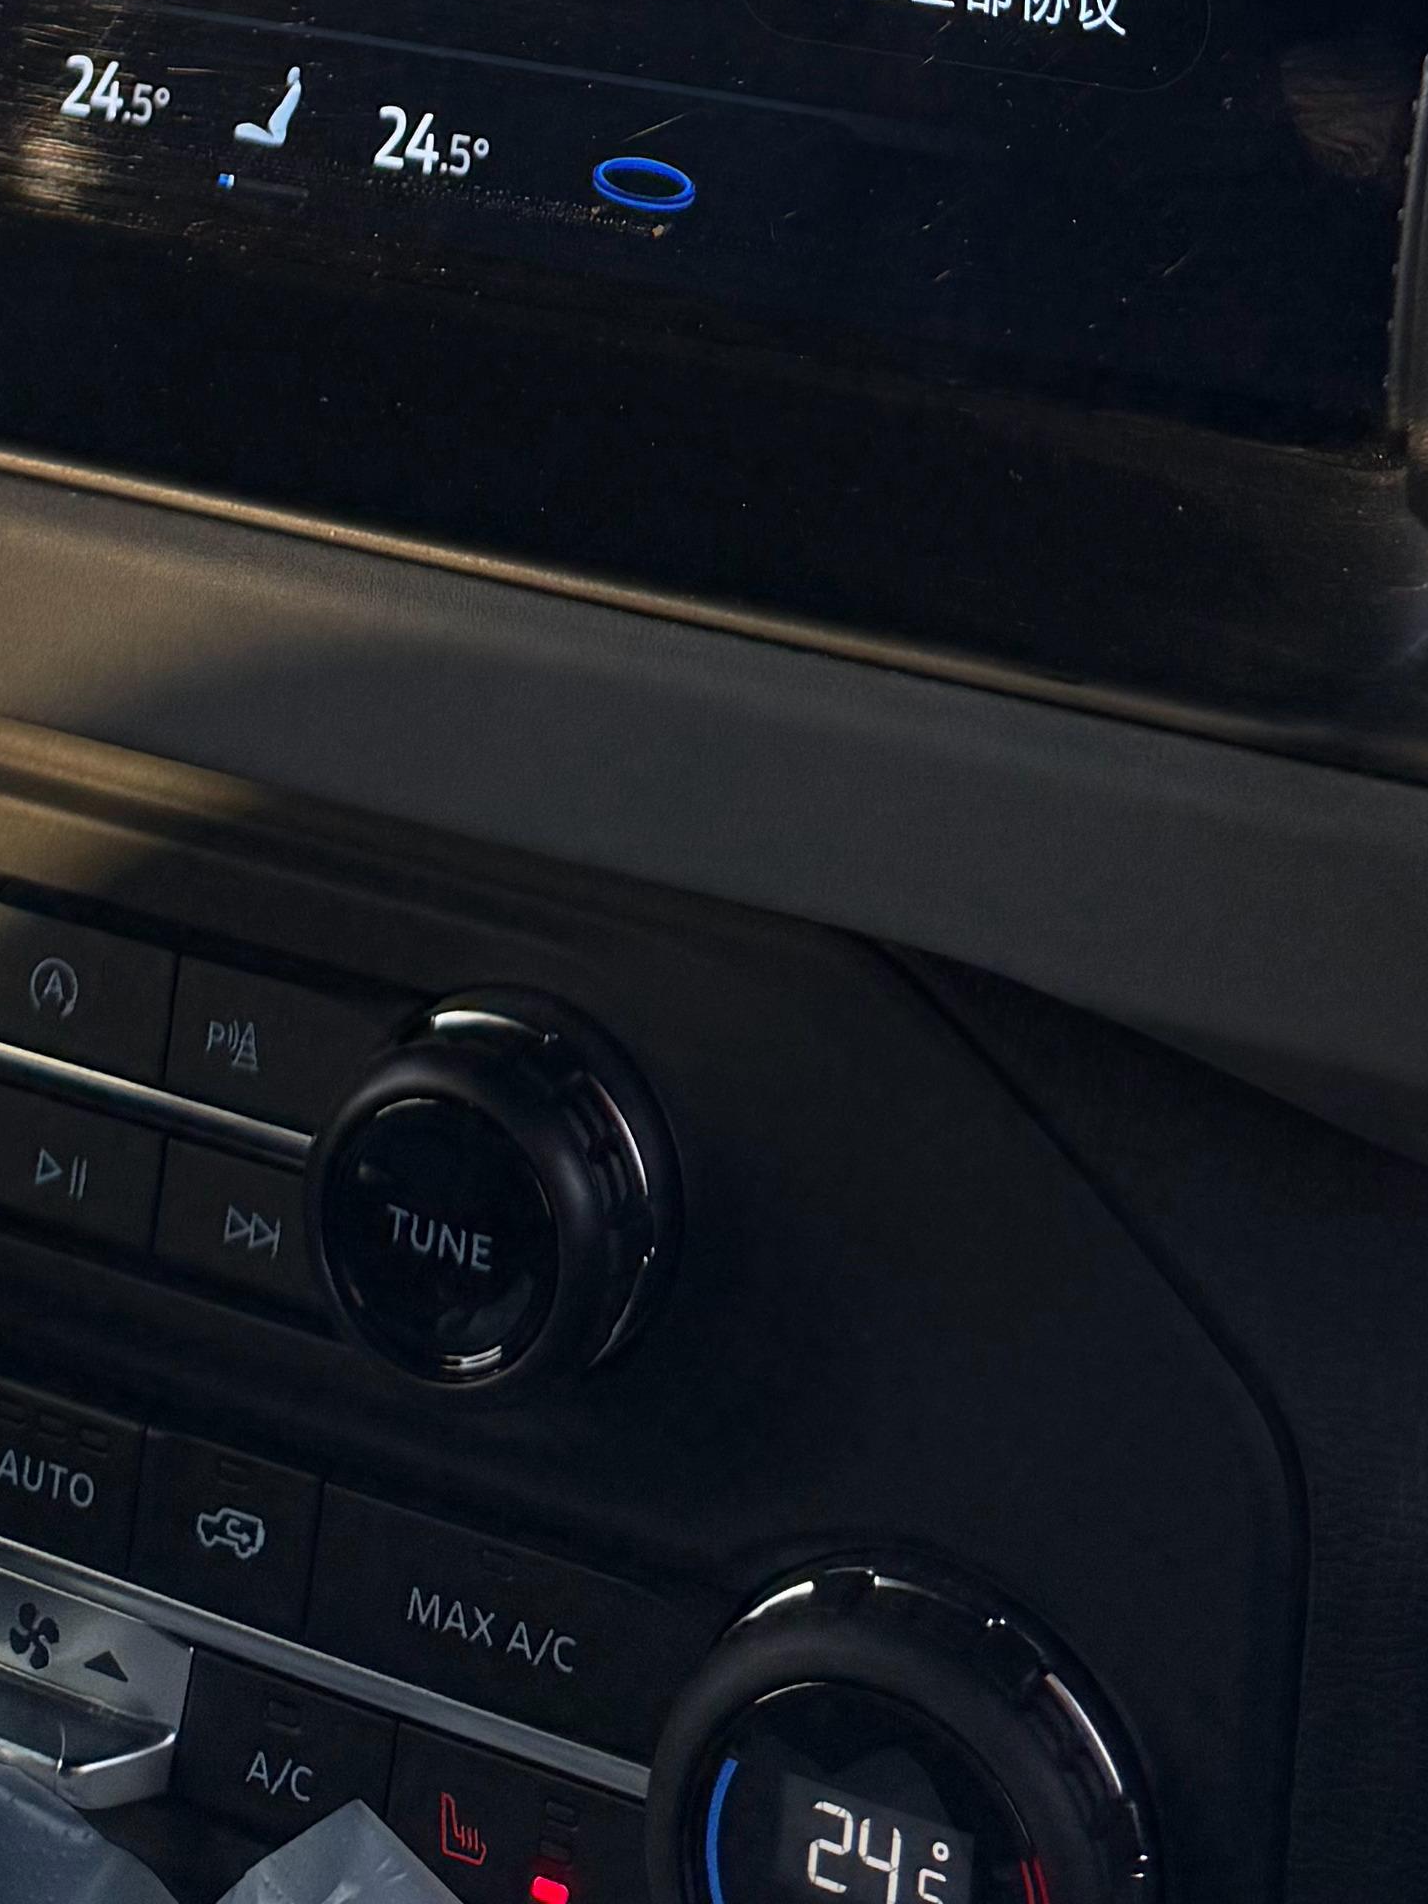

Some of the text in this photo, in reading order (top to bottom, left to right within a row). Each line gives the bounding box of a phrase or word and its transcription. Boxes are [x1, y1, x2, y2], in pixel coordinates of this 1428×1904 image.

[385, 1202, 495, 1275] TUNE
[406, 1584, 578, 1676] MAX A/C
[245, 1748, 315, 1804] A/C
